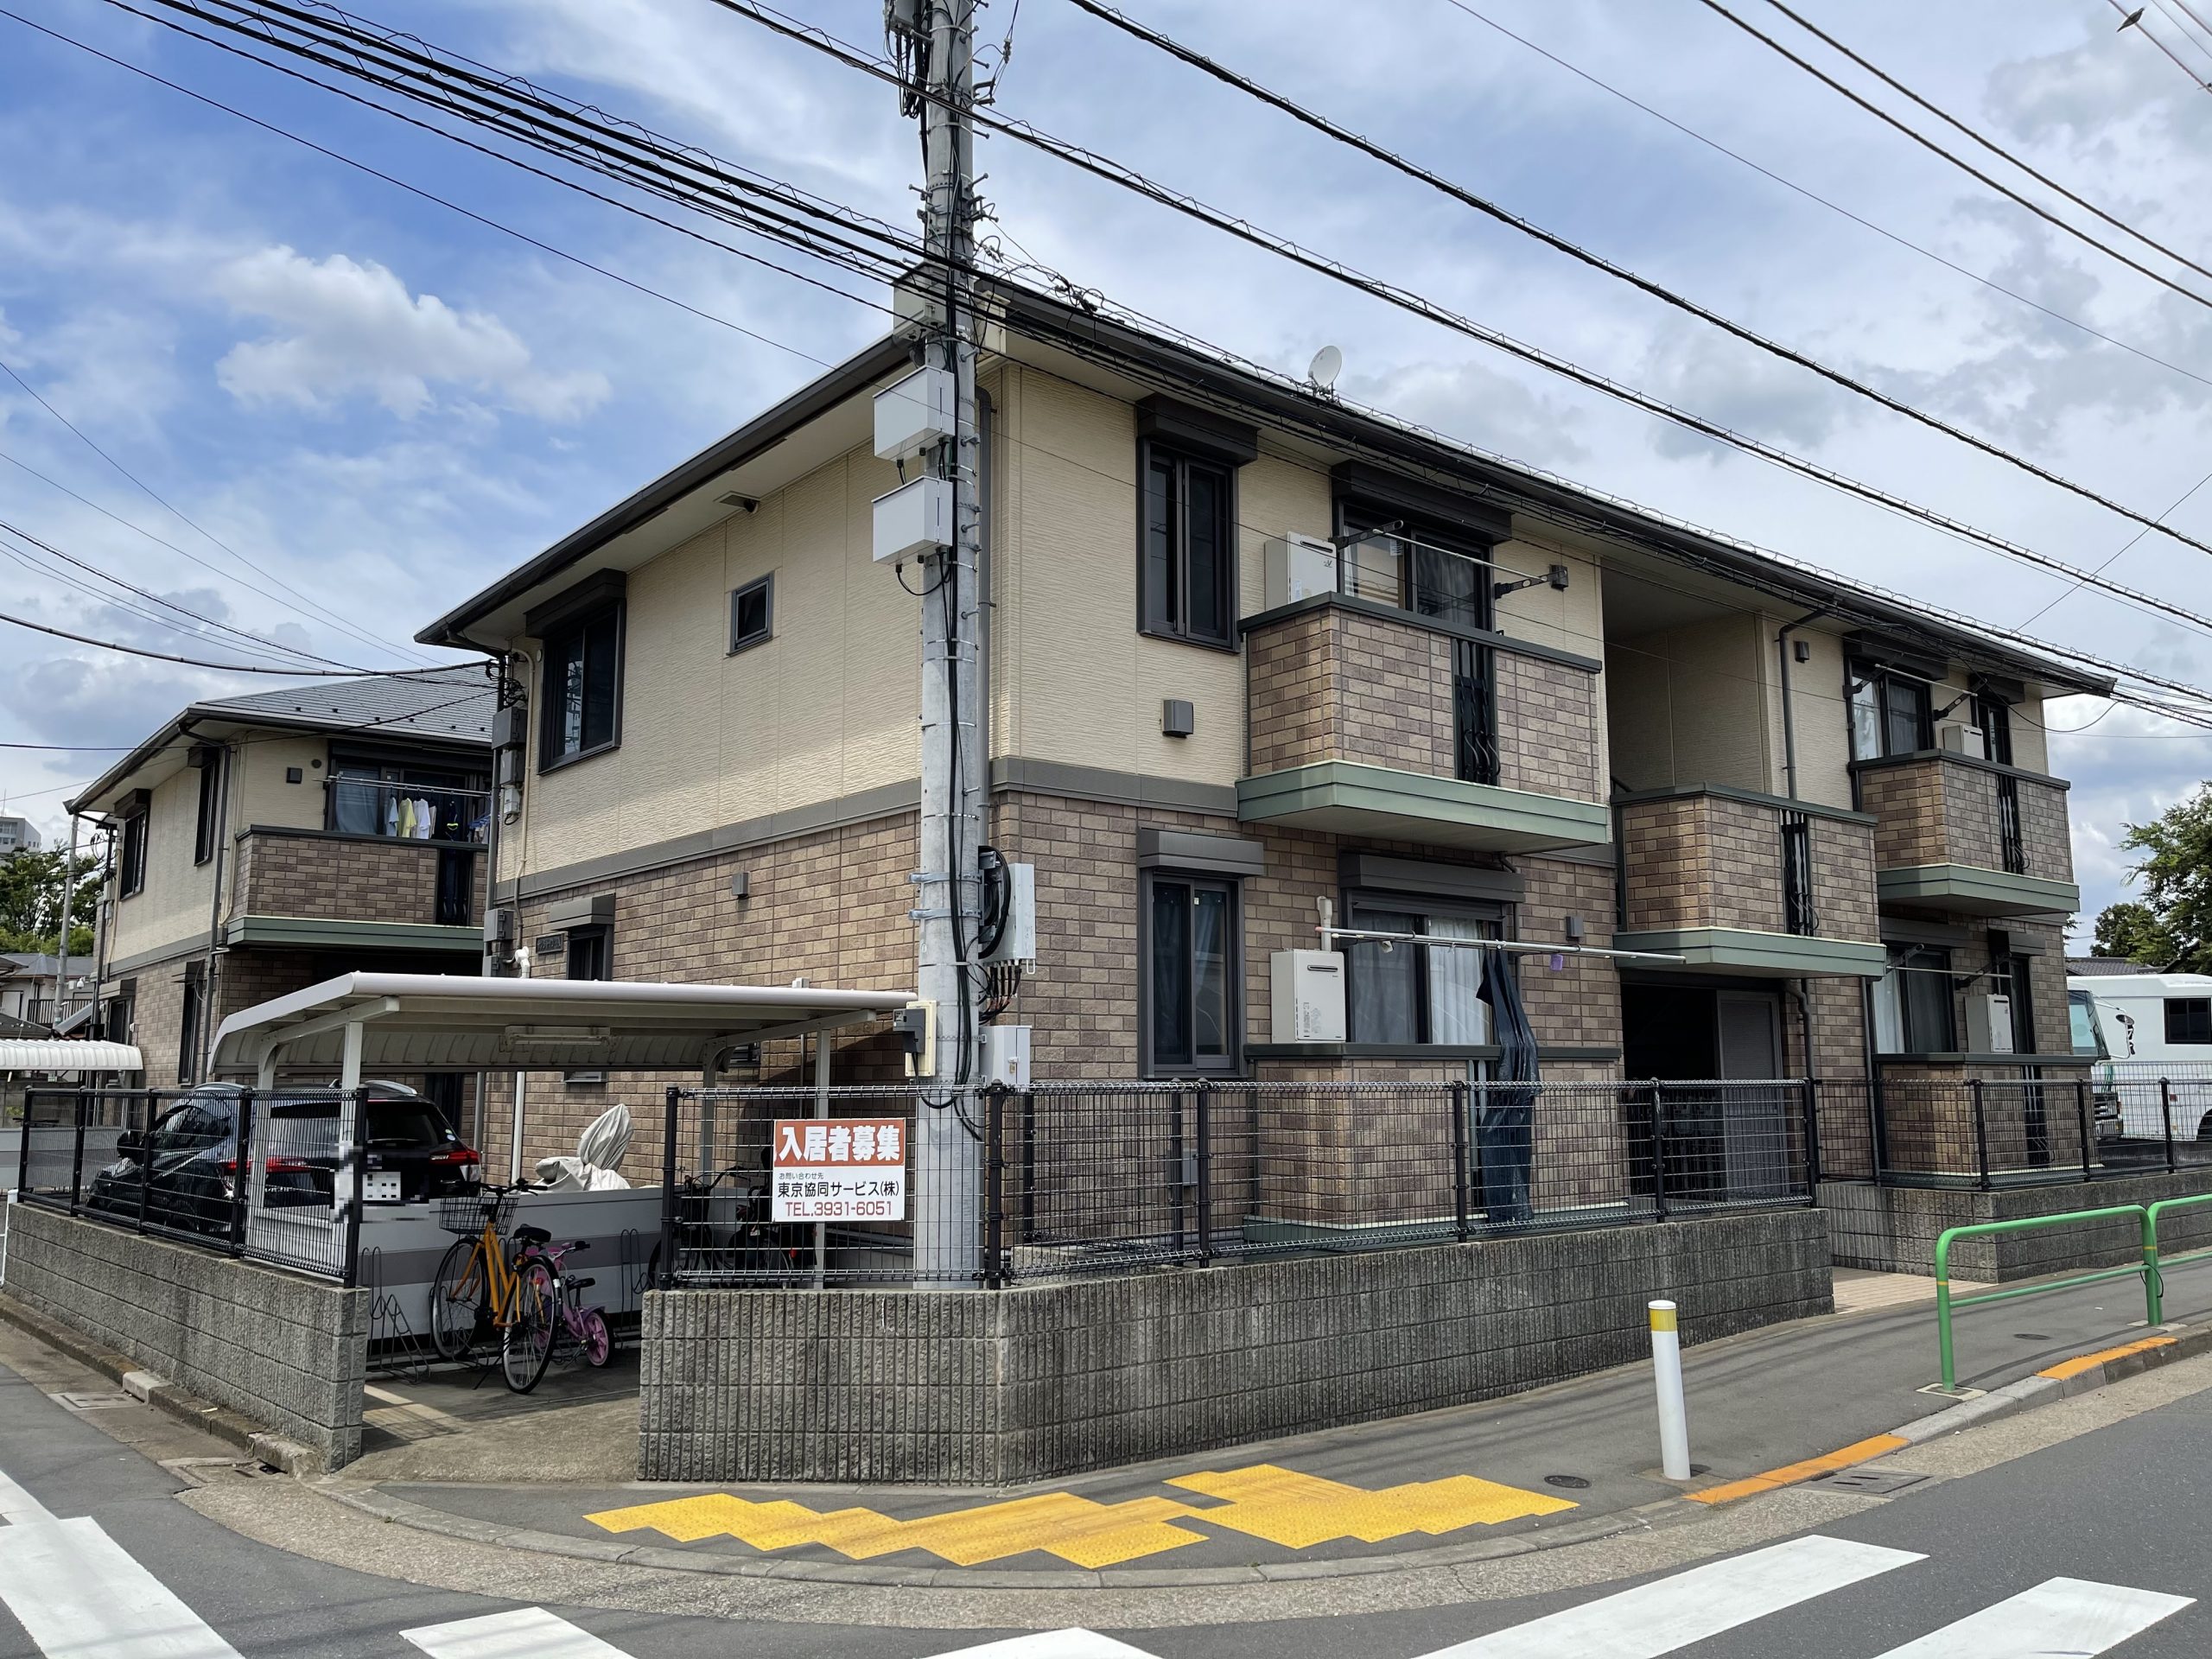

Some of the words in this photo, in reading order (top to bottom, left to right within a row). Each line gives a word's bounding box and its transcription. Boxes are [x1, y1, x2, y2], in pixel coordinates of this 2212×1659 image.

[779, 1125, 900, 1161] 入居者募集
[778, 1181, 899, 1198] 東京協同サービス(株)
[785, 1201, 892, 1217] TEL.3931-6051
